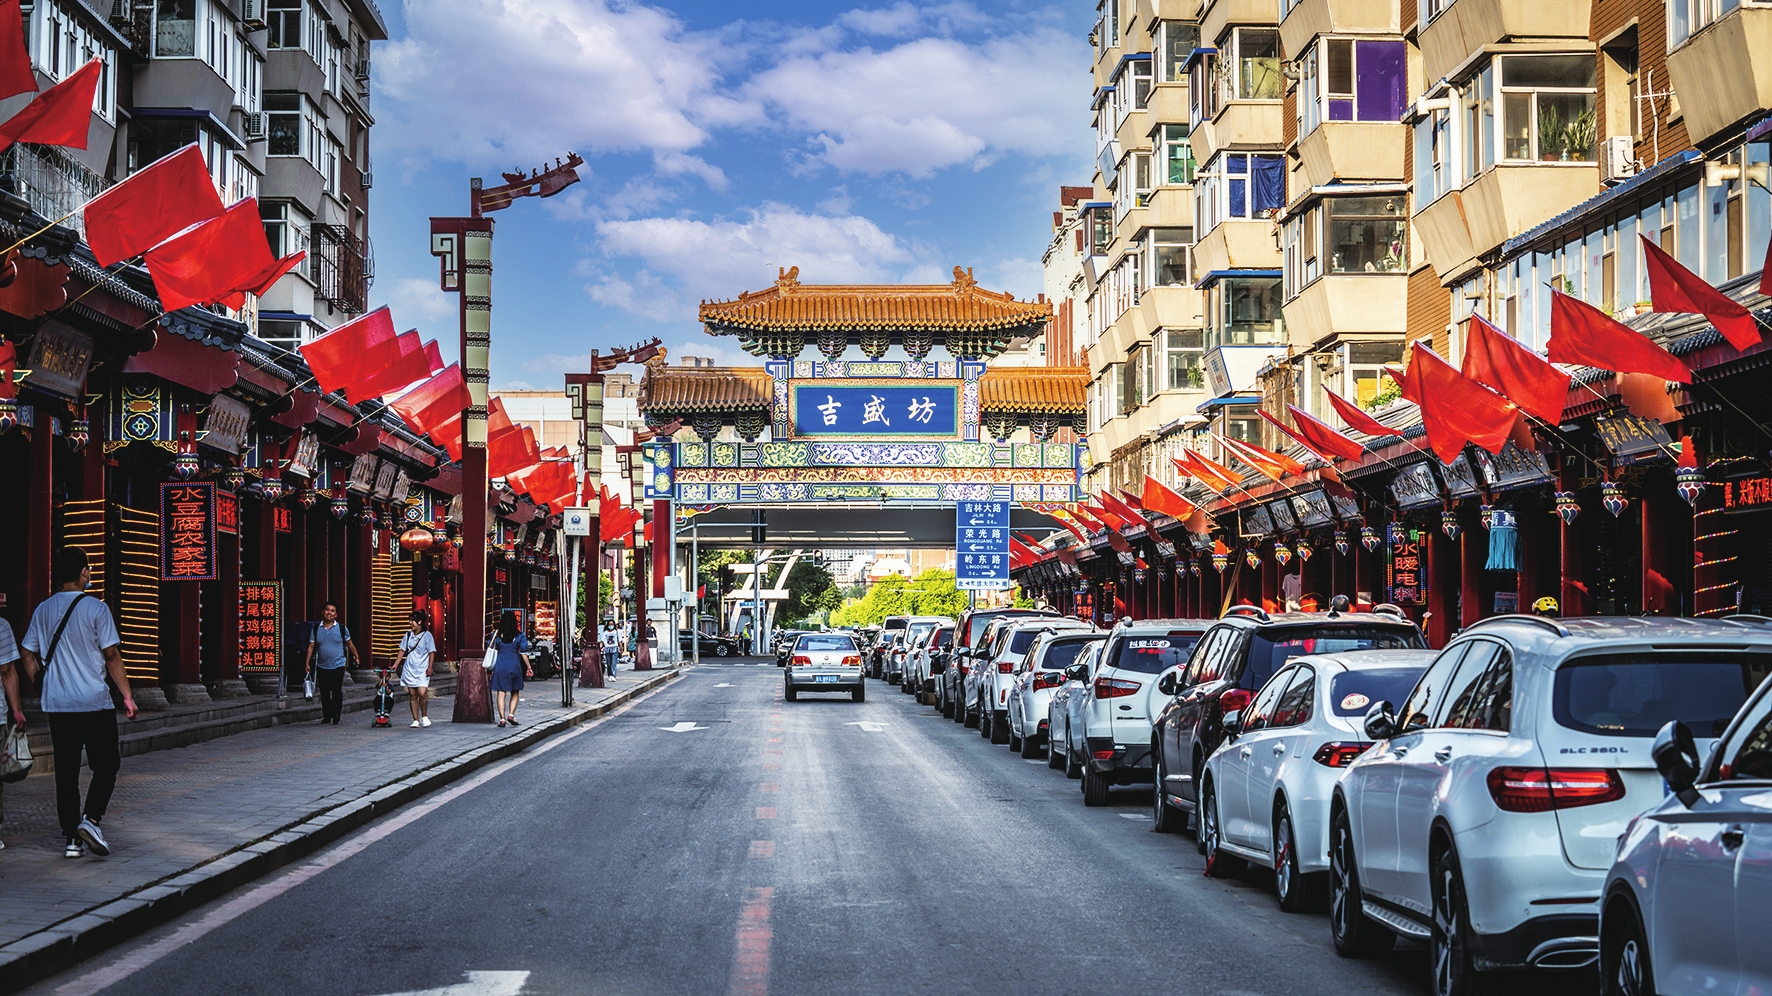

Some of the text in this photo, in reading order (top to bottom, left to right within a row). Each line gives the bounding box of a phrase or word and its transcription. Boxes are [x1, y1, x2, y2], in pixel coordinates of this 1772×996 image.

[816, 394, 937, 427] 吉盛坊
[964, 503, 1002, 513] 吉林大路
[170, 486, 207, 576] 水豆腐农家菜
[965, 529, 1001, 539] 荣光路
[964, 554, 1001, 565] 岭东路
[1394, 543, 1419, 602] 水暖电料
[239, 651, 275, 666] 头巴脑
